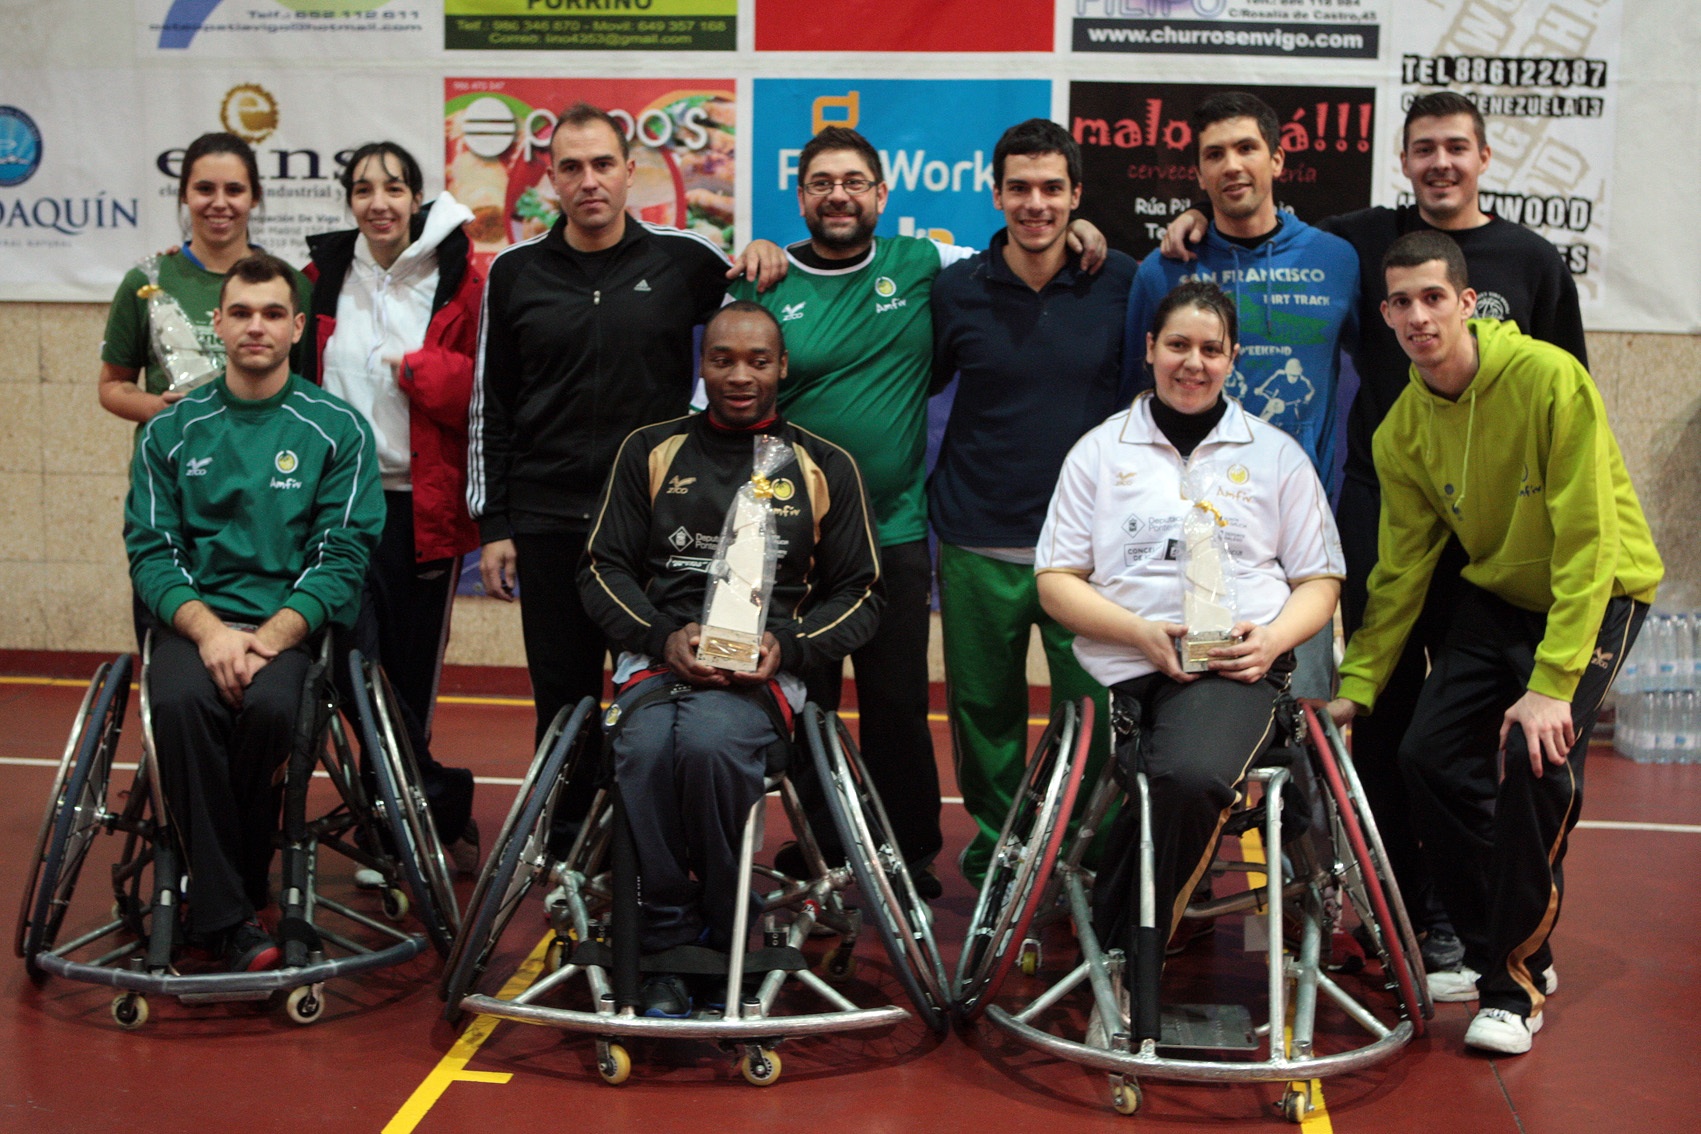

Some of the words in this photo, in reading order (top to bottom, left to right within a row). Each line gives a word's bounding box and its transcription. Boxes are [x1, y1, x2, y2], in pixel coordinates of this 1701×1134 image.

[1088, 26, 1363, 50] www.churrosenvigo.com
[1403, 57, 1450, 85] TEL
[1455, 57, 1605, 87] 886122487
[1072, 98, 1192, 150] malo
[1135, 197, 1167, 216] Rúa
[1222, 268, 1325, 283] FRANCISCO
[1293, 294, 1331, 306] TRACK
